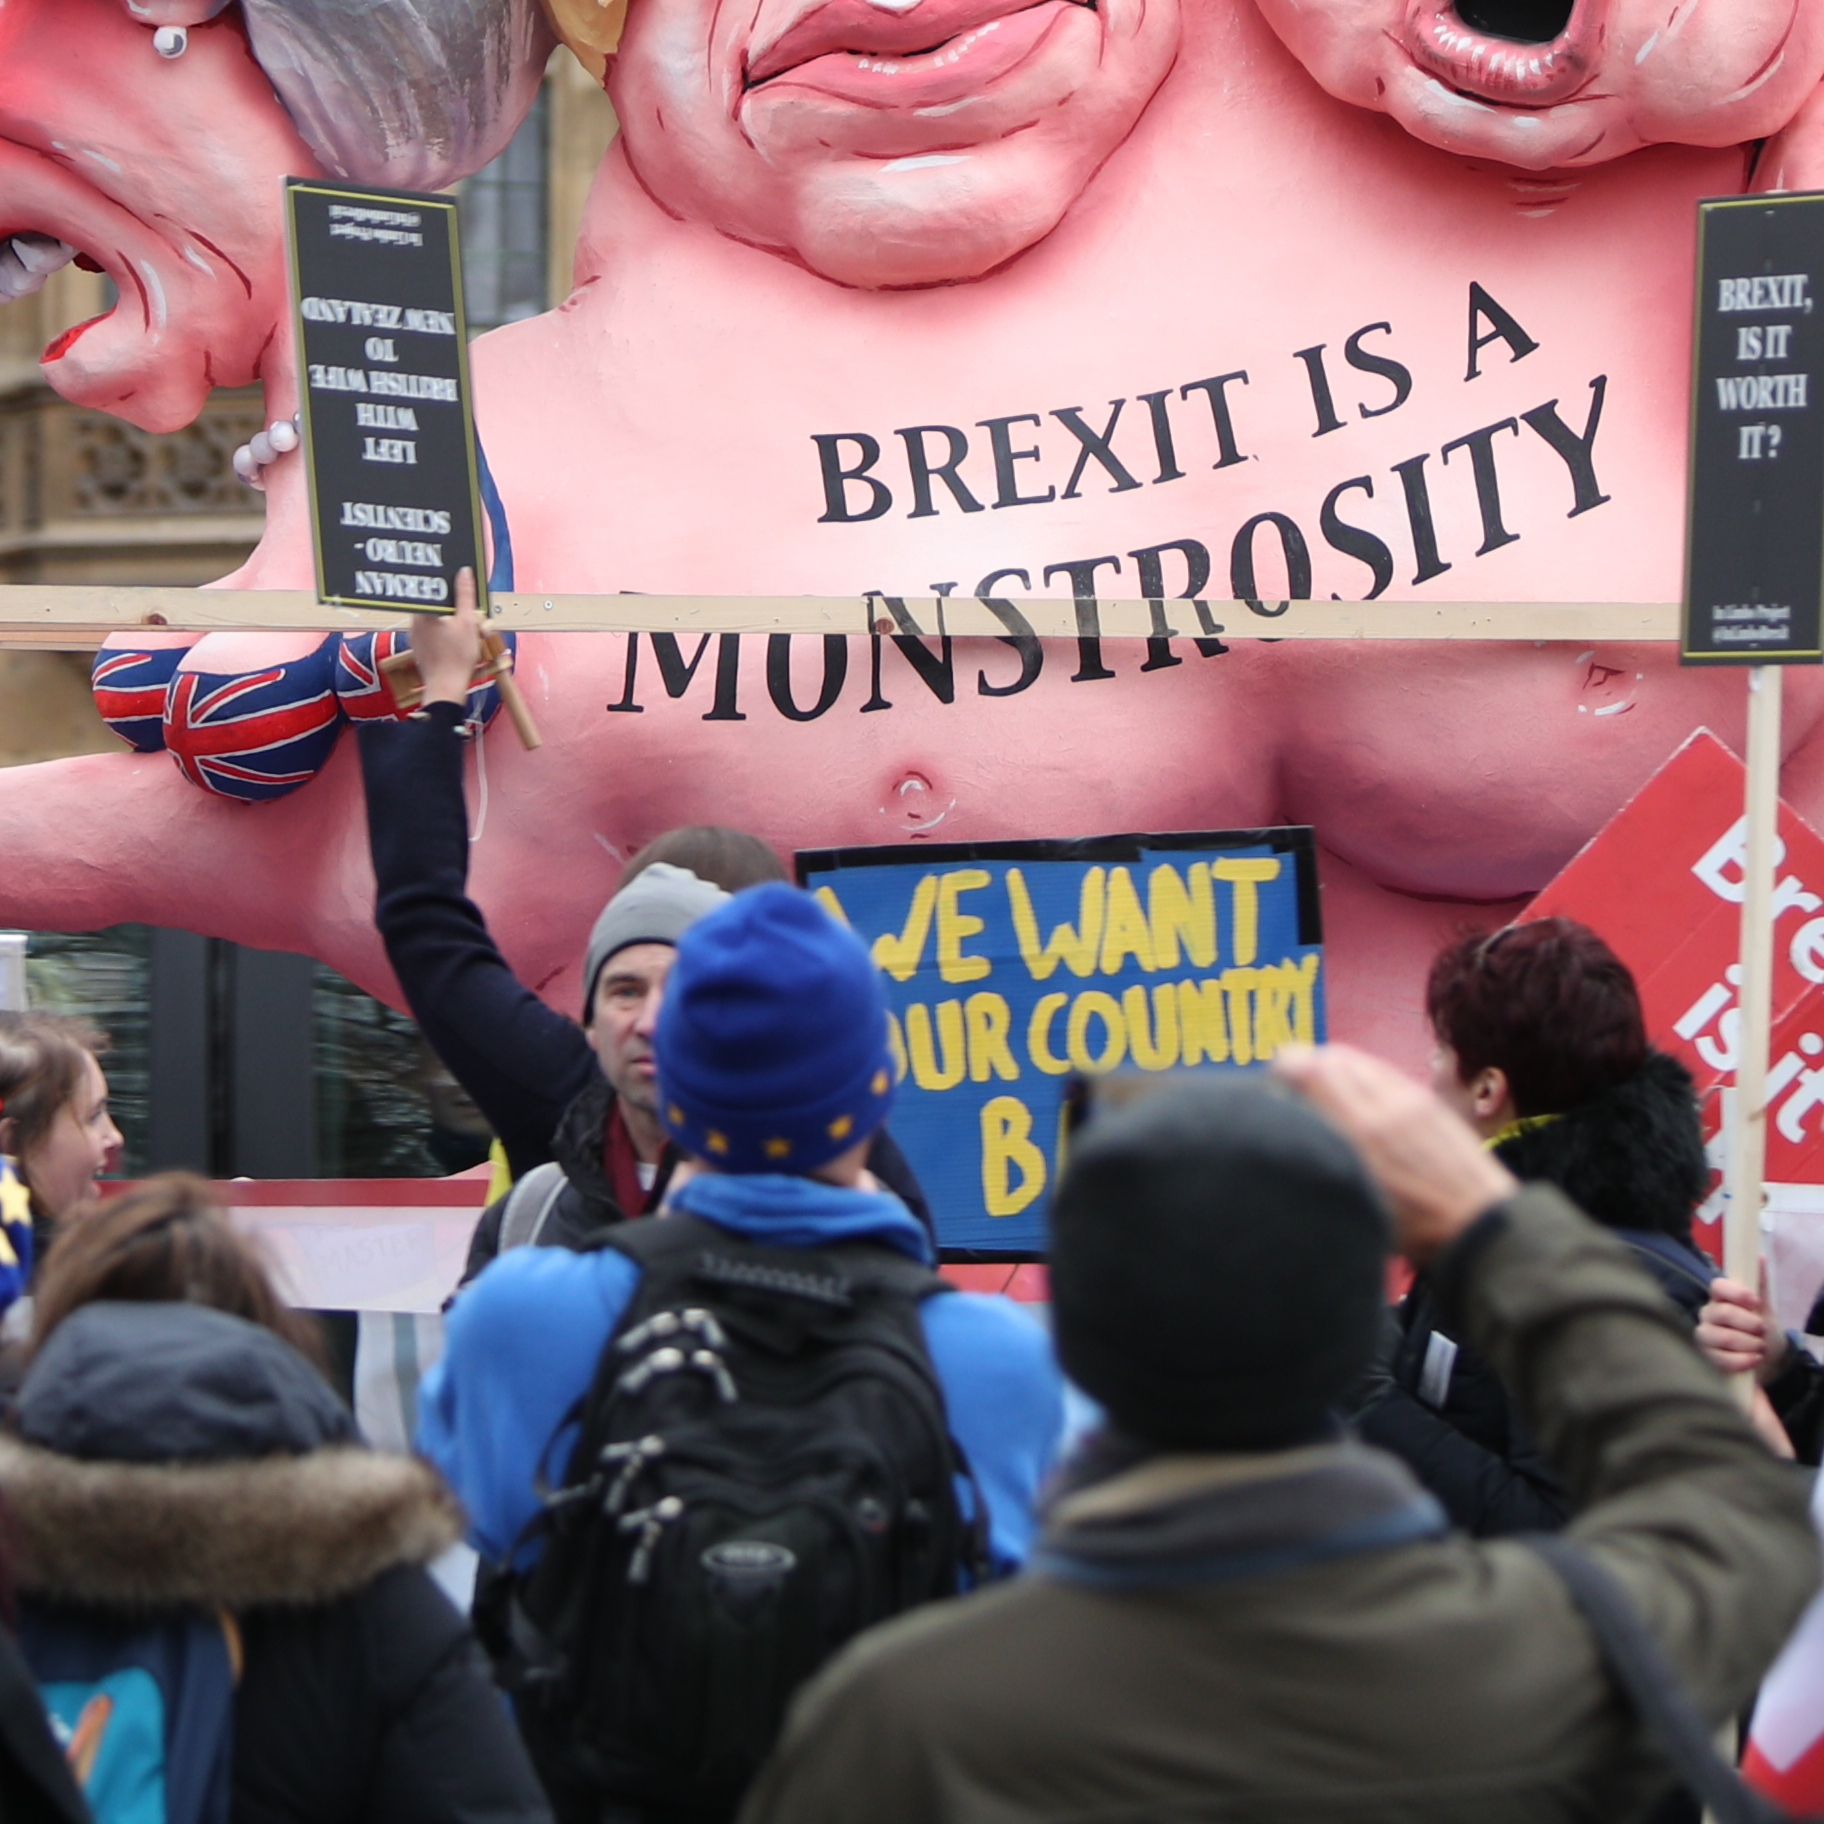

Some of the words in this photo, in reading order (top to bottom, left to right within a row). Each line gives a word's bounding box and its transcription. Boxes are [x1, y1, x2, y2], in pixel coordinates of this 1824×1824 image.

[1717, 274, 1813, 314] BREXIT,
[300, 297, 402, 329] ZEALAND
[402, 308, 456, 335] NEW
[365, 337, 399, 362] TO
[1736, 326, 1762, 360] IS
[1764, 325, 1792, 359] IT
[308, 364, 369, 392] WIFE
[369, 371, 459, 401] BRITISH
[1716, 374, 1809, 410] WORTH
[355, 403, 420, 431] WITH
[809, 370, 1253, 526] BREXIT
[1294, 319, 1412, 439] IS
[1463, 279, 1540, 383] A
[362, 437, 418, 464] LEFT
[1738, 424, 1782, 460] IT?
[340, 502, 451, 534] SCIENTIST
[606, 375, 1608, 724] MONSTROSITY
[355, 571, 448, 601] GERMAN
[1005, 857, 1282, 980] WANT
[1027, 952, 1320, 1076] COUNTRY
